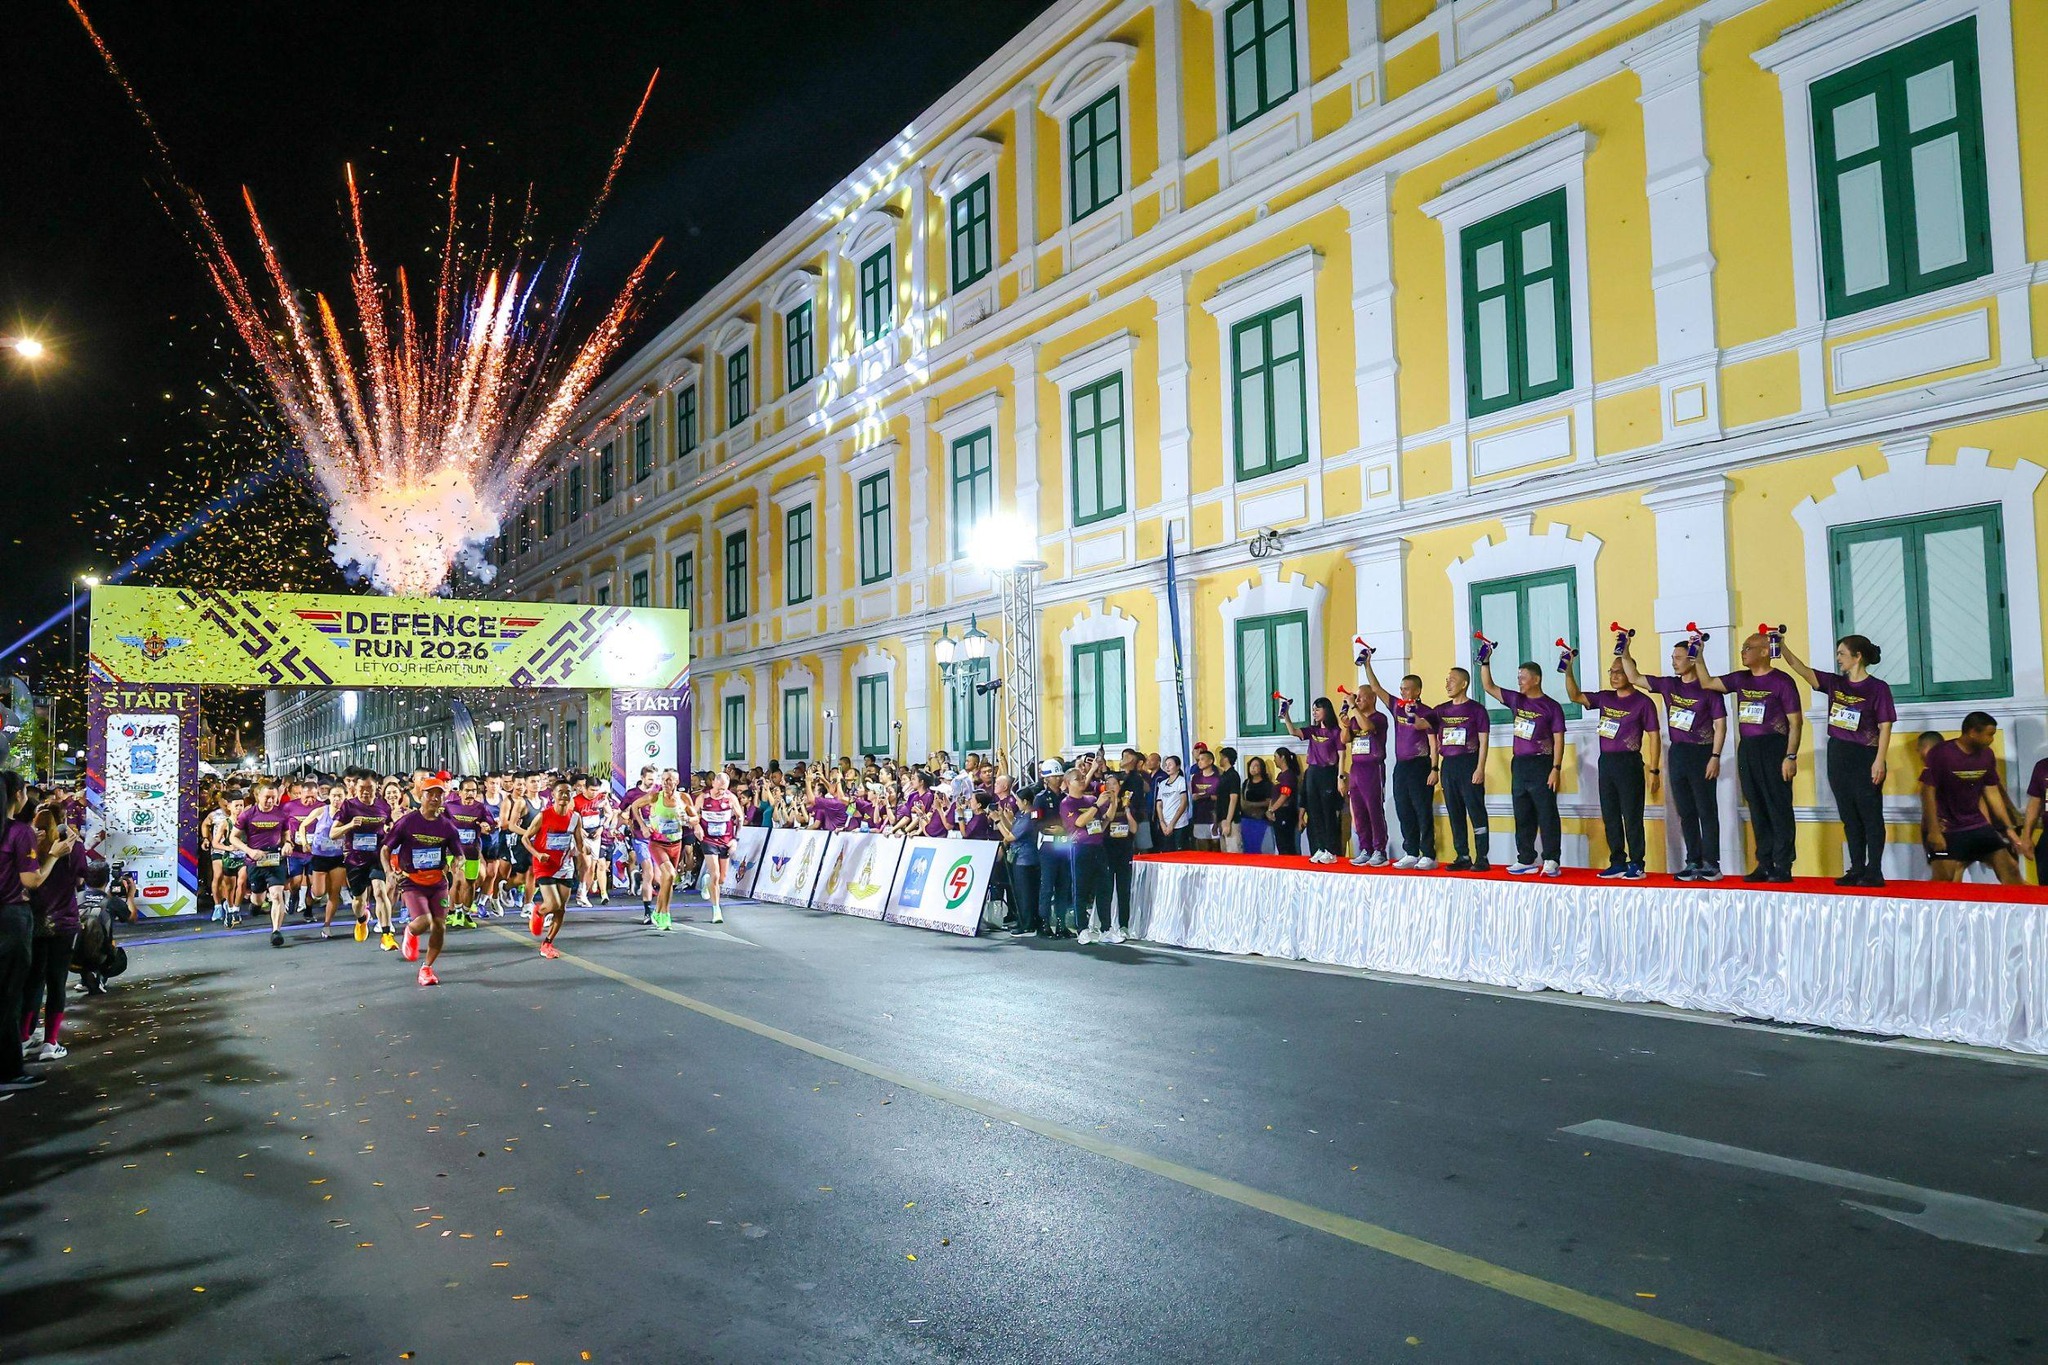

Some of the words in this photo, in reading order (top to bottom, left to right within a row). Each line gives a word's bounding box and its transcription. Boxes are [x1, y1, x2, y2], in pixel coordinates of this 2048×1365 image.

[346, 611, 498, 638] DEFENCE
[355, 639, 413, 658] RUN
[420, 640, 489, 660] 2026
[355, 662, 377, 673] LET
[381, 663, 416, 673] YOUR
[420, 663, 459, 674] HEART
[462, 664, 488, 674] RUN
[101, 691, 188, 709] START
[620, 695, 681, 711] START
[138, 724, 168, 738] ptt
[146, 870, 169, 879] Unif
[949, 866, 968, 899] PT
